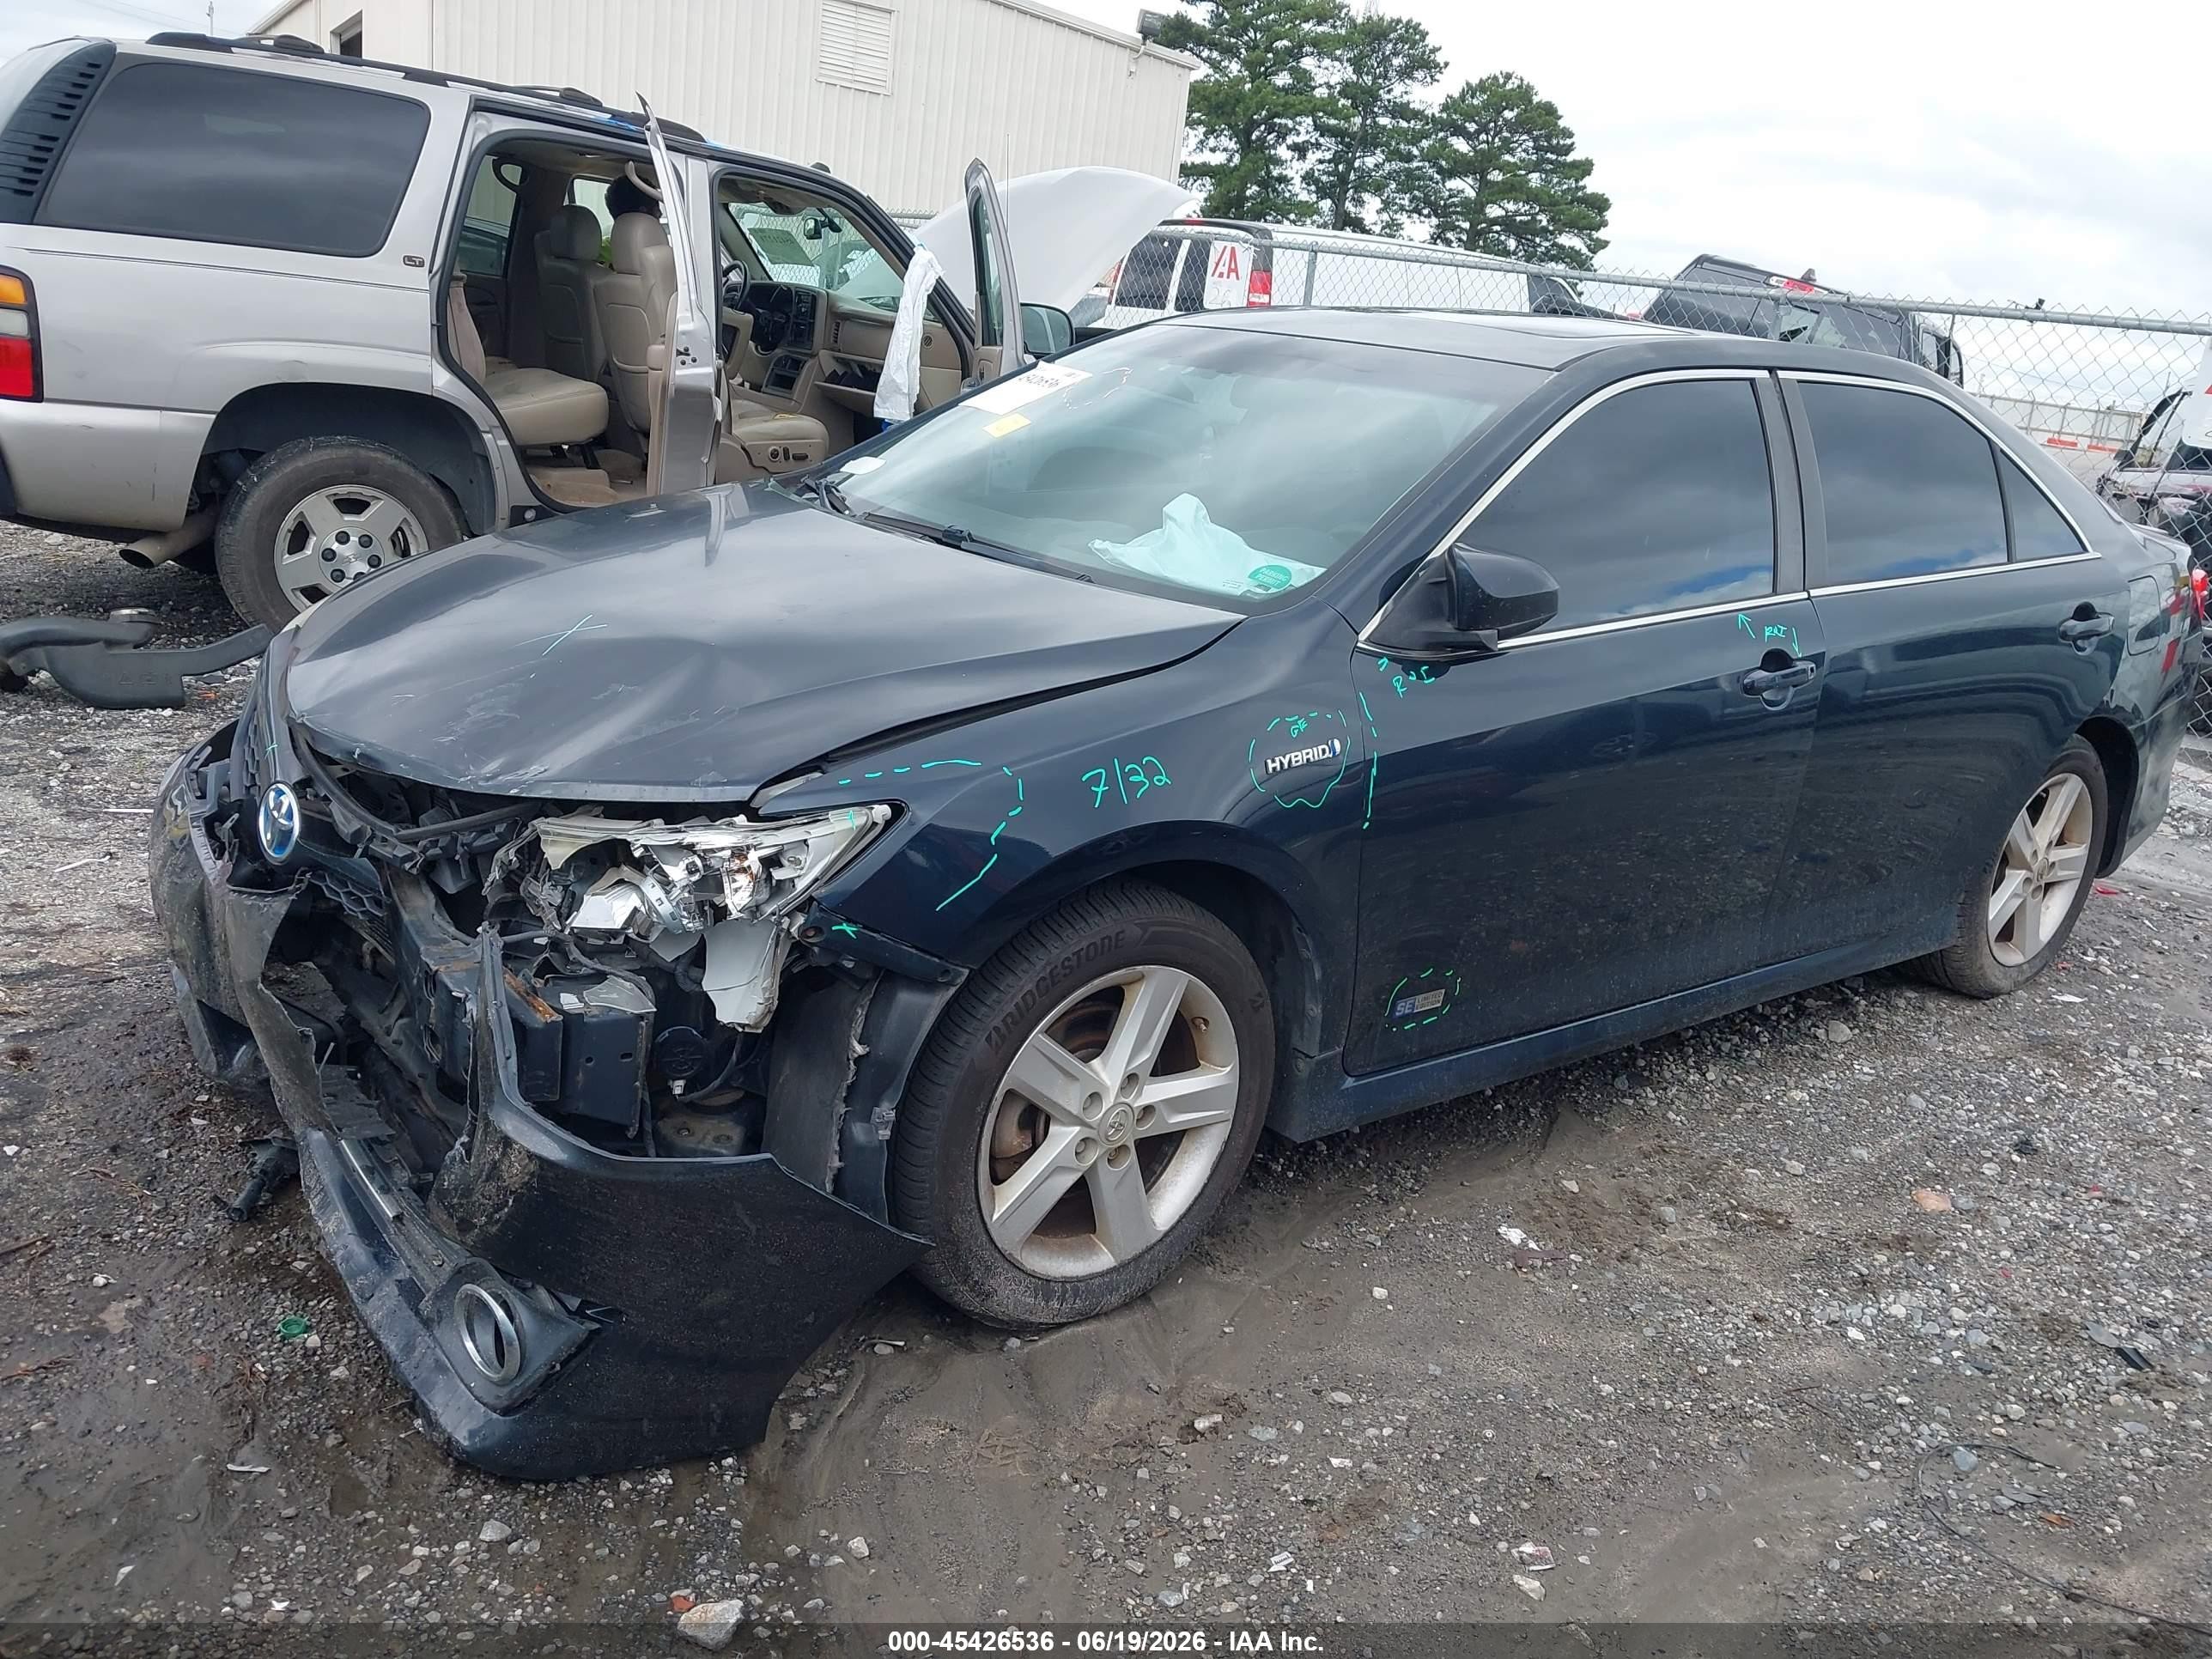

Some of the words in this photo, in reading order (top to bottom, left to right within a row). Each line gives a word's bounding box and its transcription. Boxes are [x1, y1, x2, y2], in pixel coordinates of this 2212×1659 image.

[404, 257, 423, 265] LT
[1265, 744, 1333, 774] HYBRID
[985, 930, 1126, 1053] BRIDGESTONE
[1395, 999, 1415, 1017] SE
